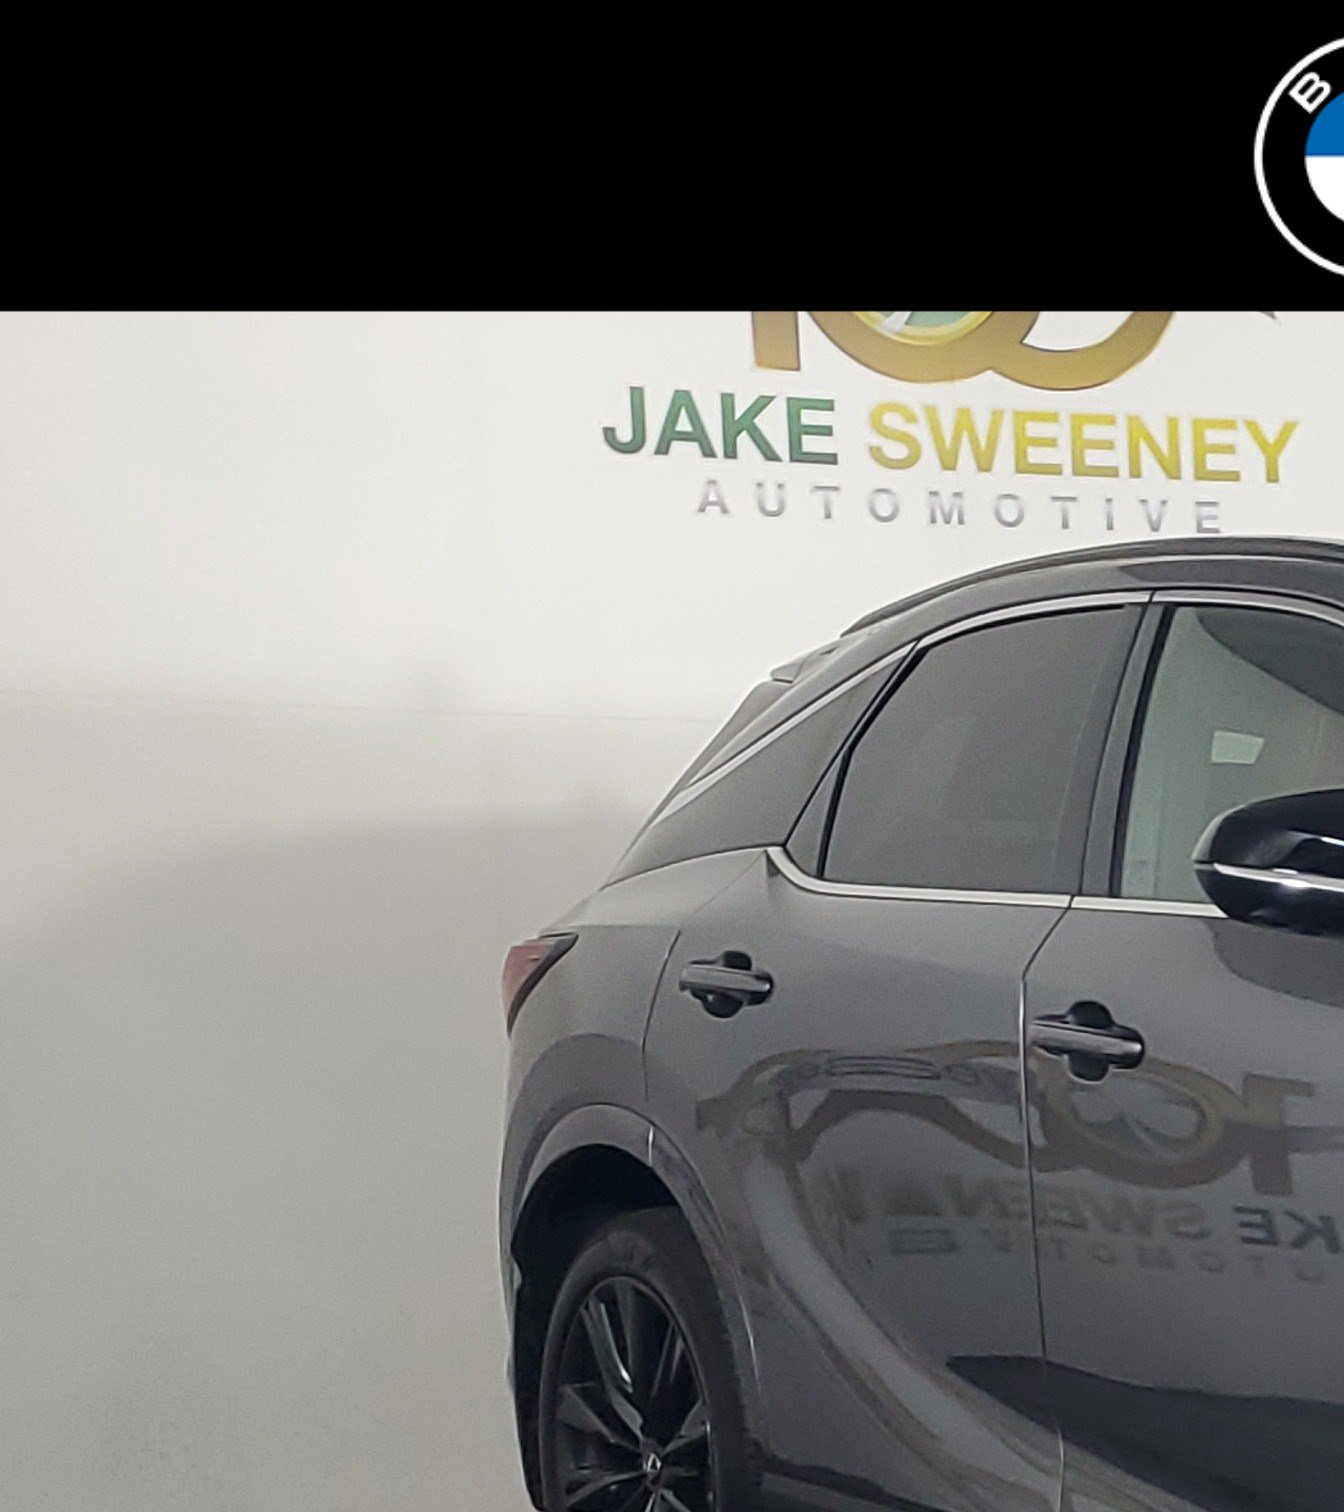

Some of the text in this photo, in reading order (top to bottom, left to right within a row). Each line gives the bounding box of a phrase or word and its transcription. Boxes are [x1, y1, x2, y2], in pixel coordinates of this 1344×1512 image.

[602, 386, 1299, 484] JAKE SWEENEY
[696, 479, 1222, 535] AUTOMOTIVE
